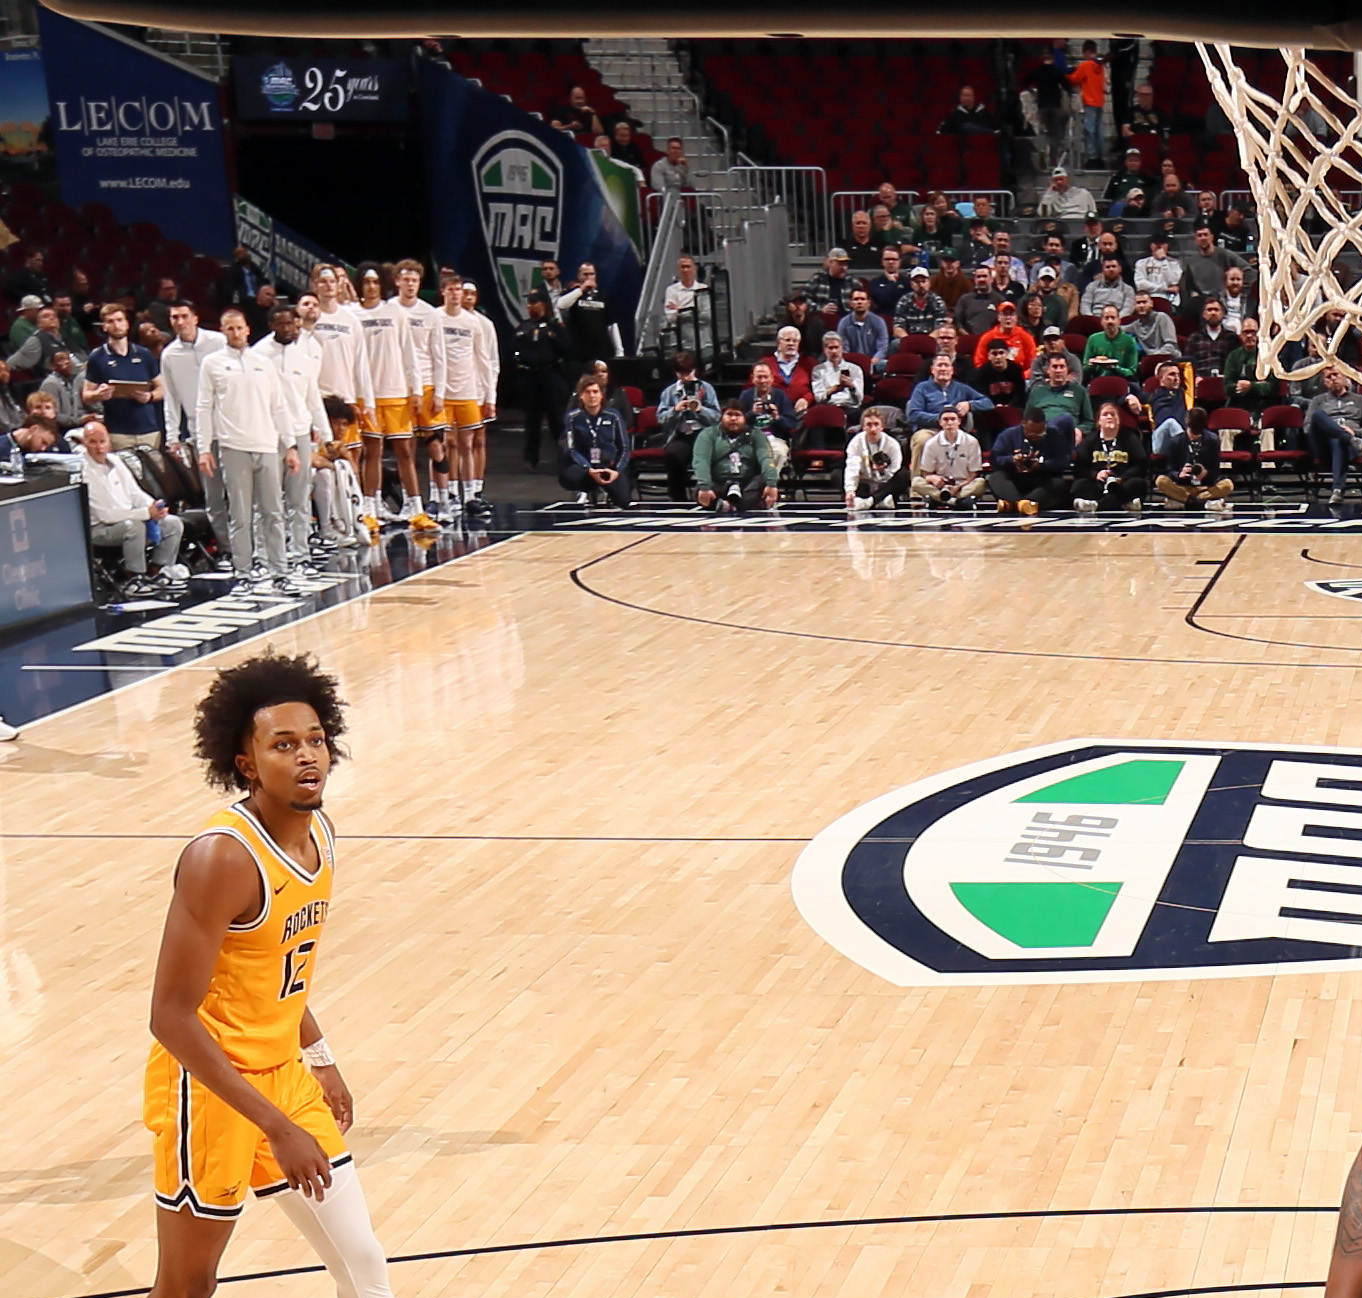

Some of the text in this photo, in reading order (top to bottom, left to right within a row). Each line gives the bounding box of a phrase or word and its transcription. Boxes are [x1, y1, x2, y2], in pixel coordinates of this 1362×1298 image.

[299, 67, 348, 111] 25
[82, 147, 198, 157] OF OSTEOPATHIC MEDICINE
[96, 137, 178, 147] LAKE ERIE COLLEGE
[99, 178, 191, 189] www.LECOM.edu
[488, 202, 559, 252] MAC
[1003, 811, 1120, 871] 1946
[277, 938, 318, 1002] 12
